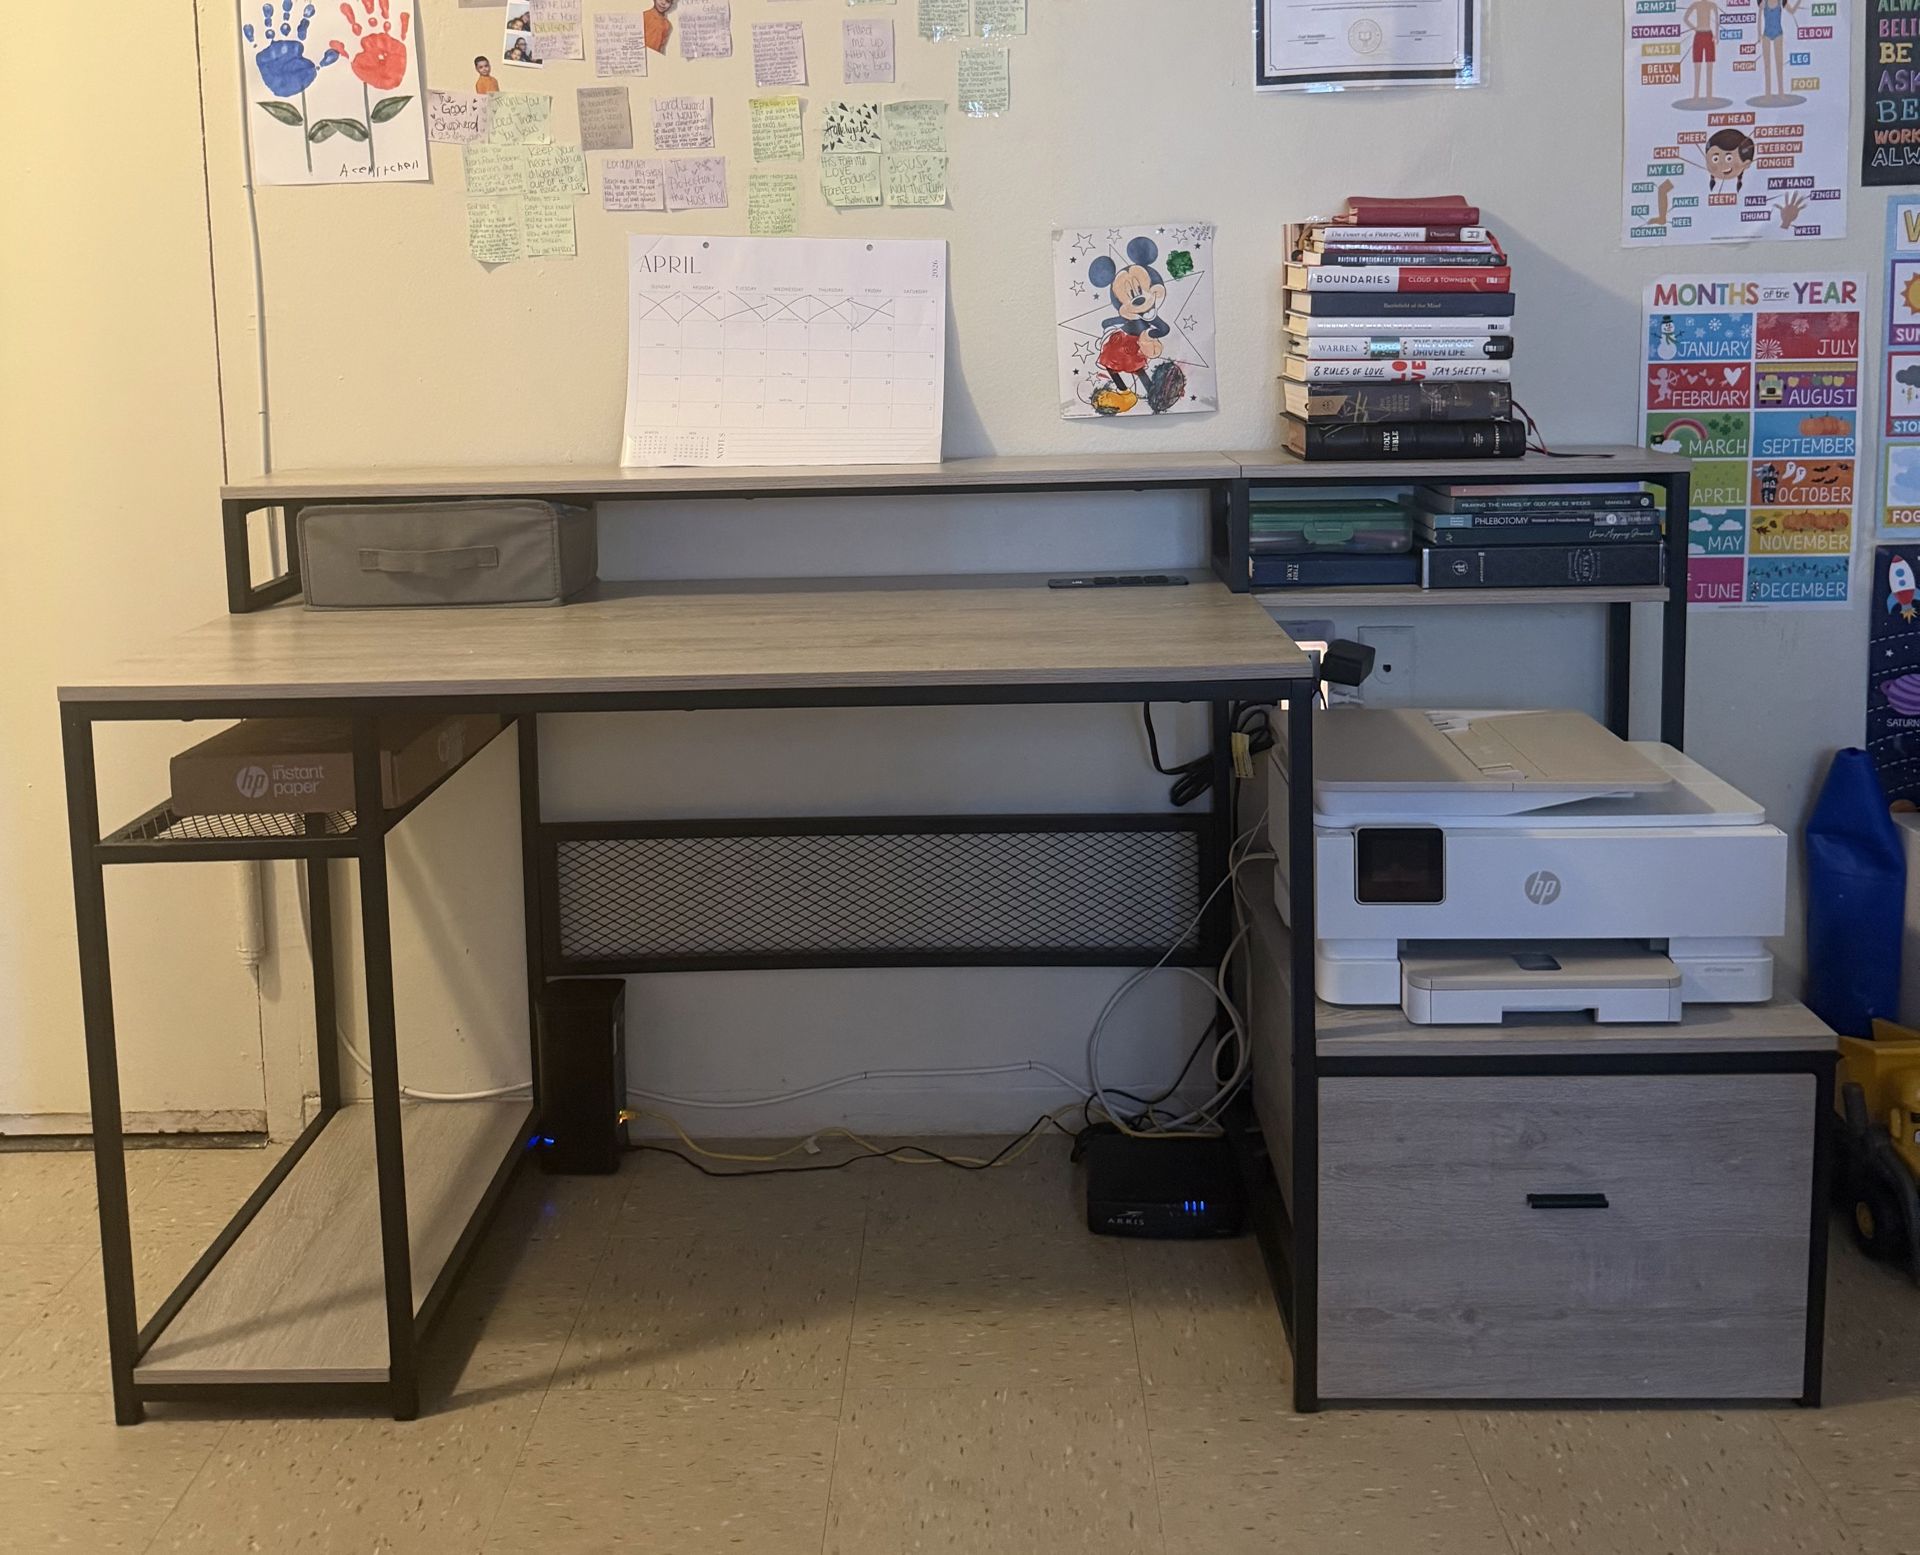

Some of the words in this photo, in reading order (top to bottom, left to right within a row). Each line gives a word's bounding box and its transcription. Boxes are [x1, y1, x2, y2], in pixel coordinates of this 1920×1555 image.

[1636, 2, 1675, 13] ARMPIT
[1812, 4, 1836, 14] ARM
[1720, 14, 1756, 22] SHOULDER
[533, 22, 576, 33] DILIGENT
[1632, 26, 1679, 37] STOMACH
[1798, 28, 1831, 38] ELBOW
[1879, 18, 1920, 38] BELI
[1721, 31, 1742, 39] CHEST
[1645, 45, 1676, 54] WAIST
[1741, 45, 1755, 53] HIP
[1879, 42, 1913, 64] BE
[1791, 54, 1808, 64] LEG
[1647, 64, 1674, 74] BELLY
[1734, 62, 1756, 70] THIGH
[1642, 74, 1679, 84] BUTTON
[1792, 80, 1818, 89] FOOT
[441, 101, 468, 116] Good
[434, 115, 478, 133] Shepherd
[1710, 116, 1725, 124] MY
[1728, 114, 1752, 123] HEAD
[1755, 127, 1803, 137] FOREHEAD
[1678, 133, 1706, 143] CHEEK
[1654, 148, 1679, 158] CHIN
[1758, 143, 1801, 153] EYEBROW
[1757, 158, 1793, 168] TONGUE
[825, 165, 853, 178] LOVE
[1648, 166, 1662, 175] MY
[1666, 166, 1683, 174] LEG
[1769, 179, 1784, 188] MY
[1787, 178, 1813, 187] HAND
[1709, 195, 1736, 204] TEETH
[1810, 191, 1840, 199] FINGER
[1632, 207, 1648, 215] TOE
[1741, 213, 1769, 221] THUMB
[1673, 219, 1691, 227] HEEL
[1375, 231, 1401, 239] PRAYING
[1631, 228, 1666, 237] TOENAIL
[1795, 227, 1820, 235] WRIST
[639, 254, 702, 274] APRIL
[1316, 274, 1391, 285] BOUNDARIES
[1408, 276, 1431, 284] CLOUD
[1440, 275, 1477, 284] TOWNSEND
[1653, 281, 1759, 307] MONTHS
[1763, 289, 1774, 299] of
[1775, 288, 1790, 299] the
[1793, 280, 1858, 305] YEAR
[1318, 344, 1357, 352] WARREN
[1413, 339, 1430, 348] THE
[1432, 339, 1475, 348] PURPOSE
[1677, 340, 1750, 357] JANUARY
[1817, 339, 1857, 356] JULY
[1412, 349, 1446, 357] DRIVEN
[1448, 349, 1466, 357] LIFE
[1313, 366, 1321, 376] 8
[1323, 366, 1350, 376] RULES
[1353, 366, 1362, 376] OF
[1363, 366, 1385, 378] LOVE
[1432, 366, 1450, 376] JAY
[1451, 366, 1487, 377] SHETTY
[1672, 390, 1749, 406] FEBRUARY
[1788, 388, 1856, 405] AUGUST
[1894, 420, 1920, 433] STO
[1382, 431, 1391, 452] HOLY
[1391, 430, 1399, 452] BIBLE
[1762, 438, 1855, 455] SEPTEMBER
[1688, 439, 1748, 455] MARCH
[1692, 487, 1744, 504] APRIL
[1778, 487, 1851, 503] OCTOBER
[1474, 516, 1529, 526] PHLEBOTOMY
[1707, 535, 1743, 551] MAY
[1759, 534, 1849, 551] NOVEMBER
[1694, 583, 1741, 600] JUNE
[1760, 582, 1846, 599] DECEMBER
[1886, 718, 1920, 727] SATURN
[236, 766, 269, 799] hp
[271, 764, 325, 780] instant
[273, 780, 320, 798] paper
[1524, 870, 1562, 905] hp
